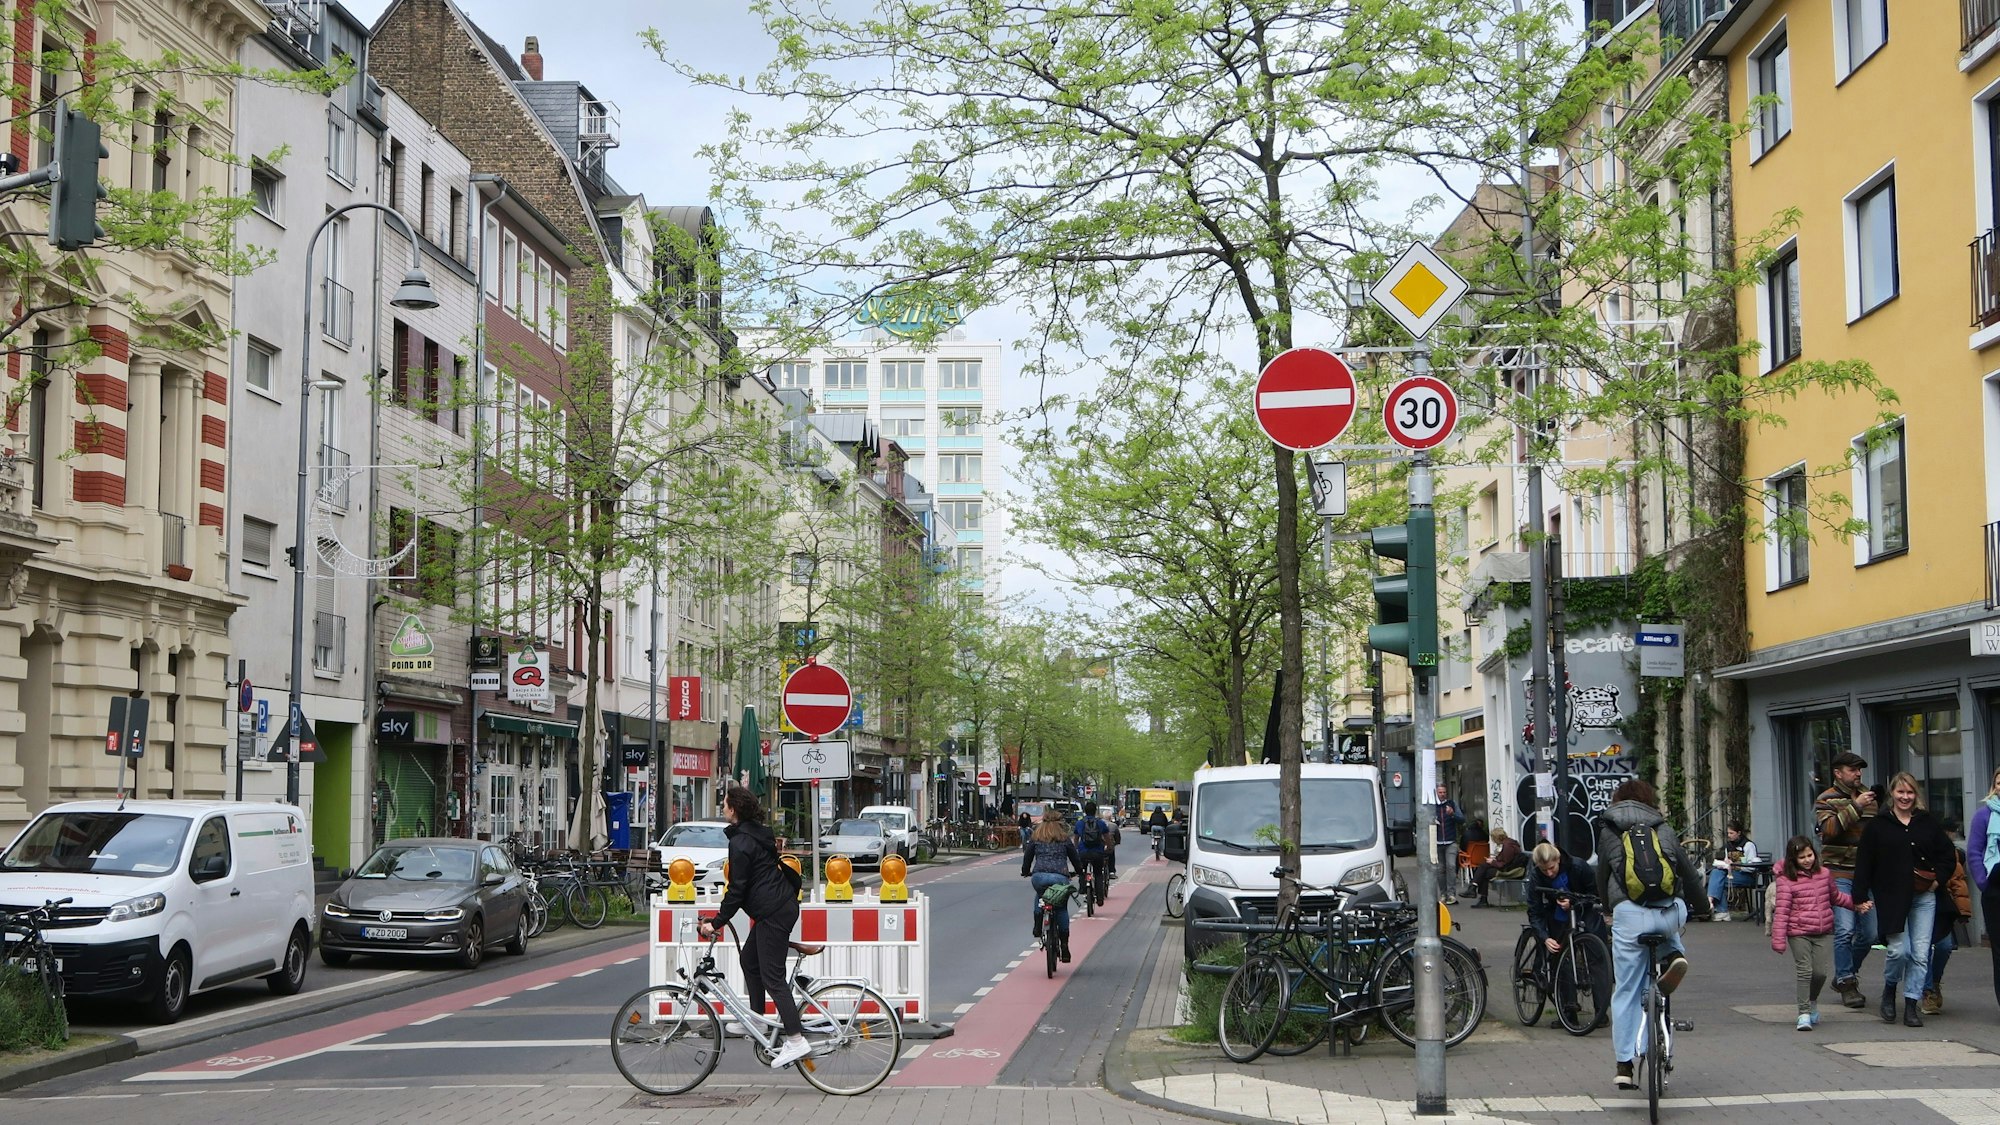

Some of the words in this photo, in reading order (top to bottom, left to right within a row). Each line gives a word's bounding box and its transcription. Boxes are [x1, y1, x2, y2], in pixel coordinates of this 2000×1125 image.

[1399, 397, 1441, 430] 30
[1643, 635, 1664, 643] Allianz
[512, 666, 546, 688] Q
[679, 680, 691, 718] tipico
[381, 718, 409, 736] sky
[625, 749, 646, 762] sky
[807, 765, 821, 774] frei
[386, 930, 406, 938] 2002
